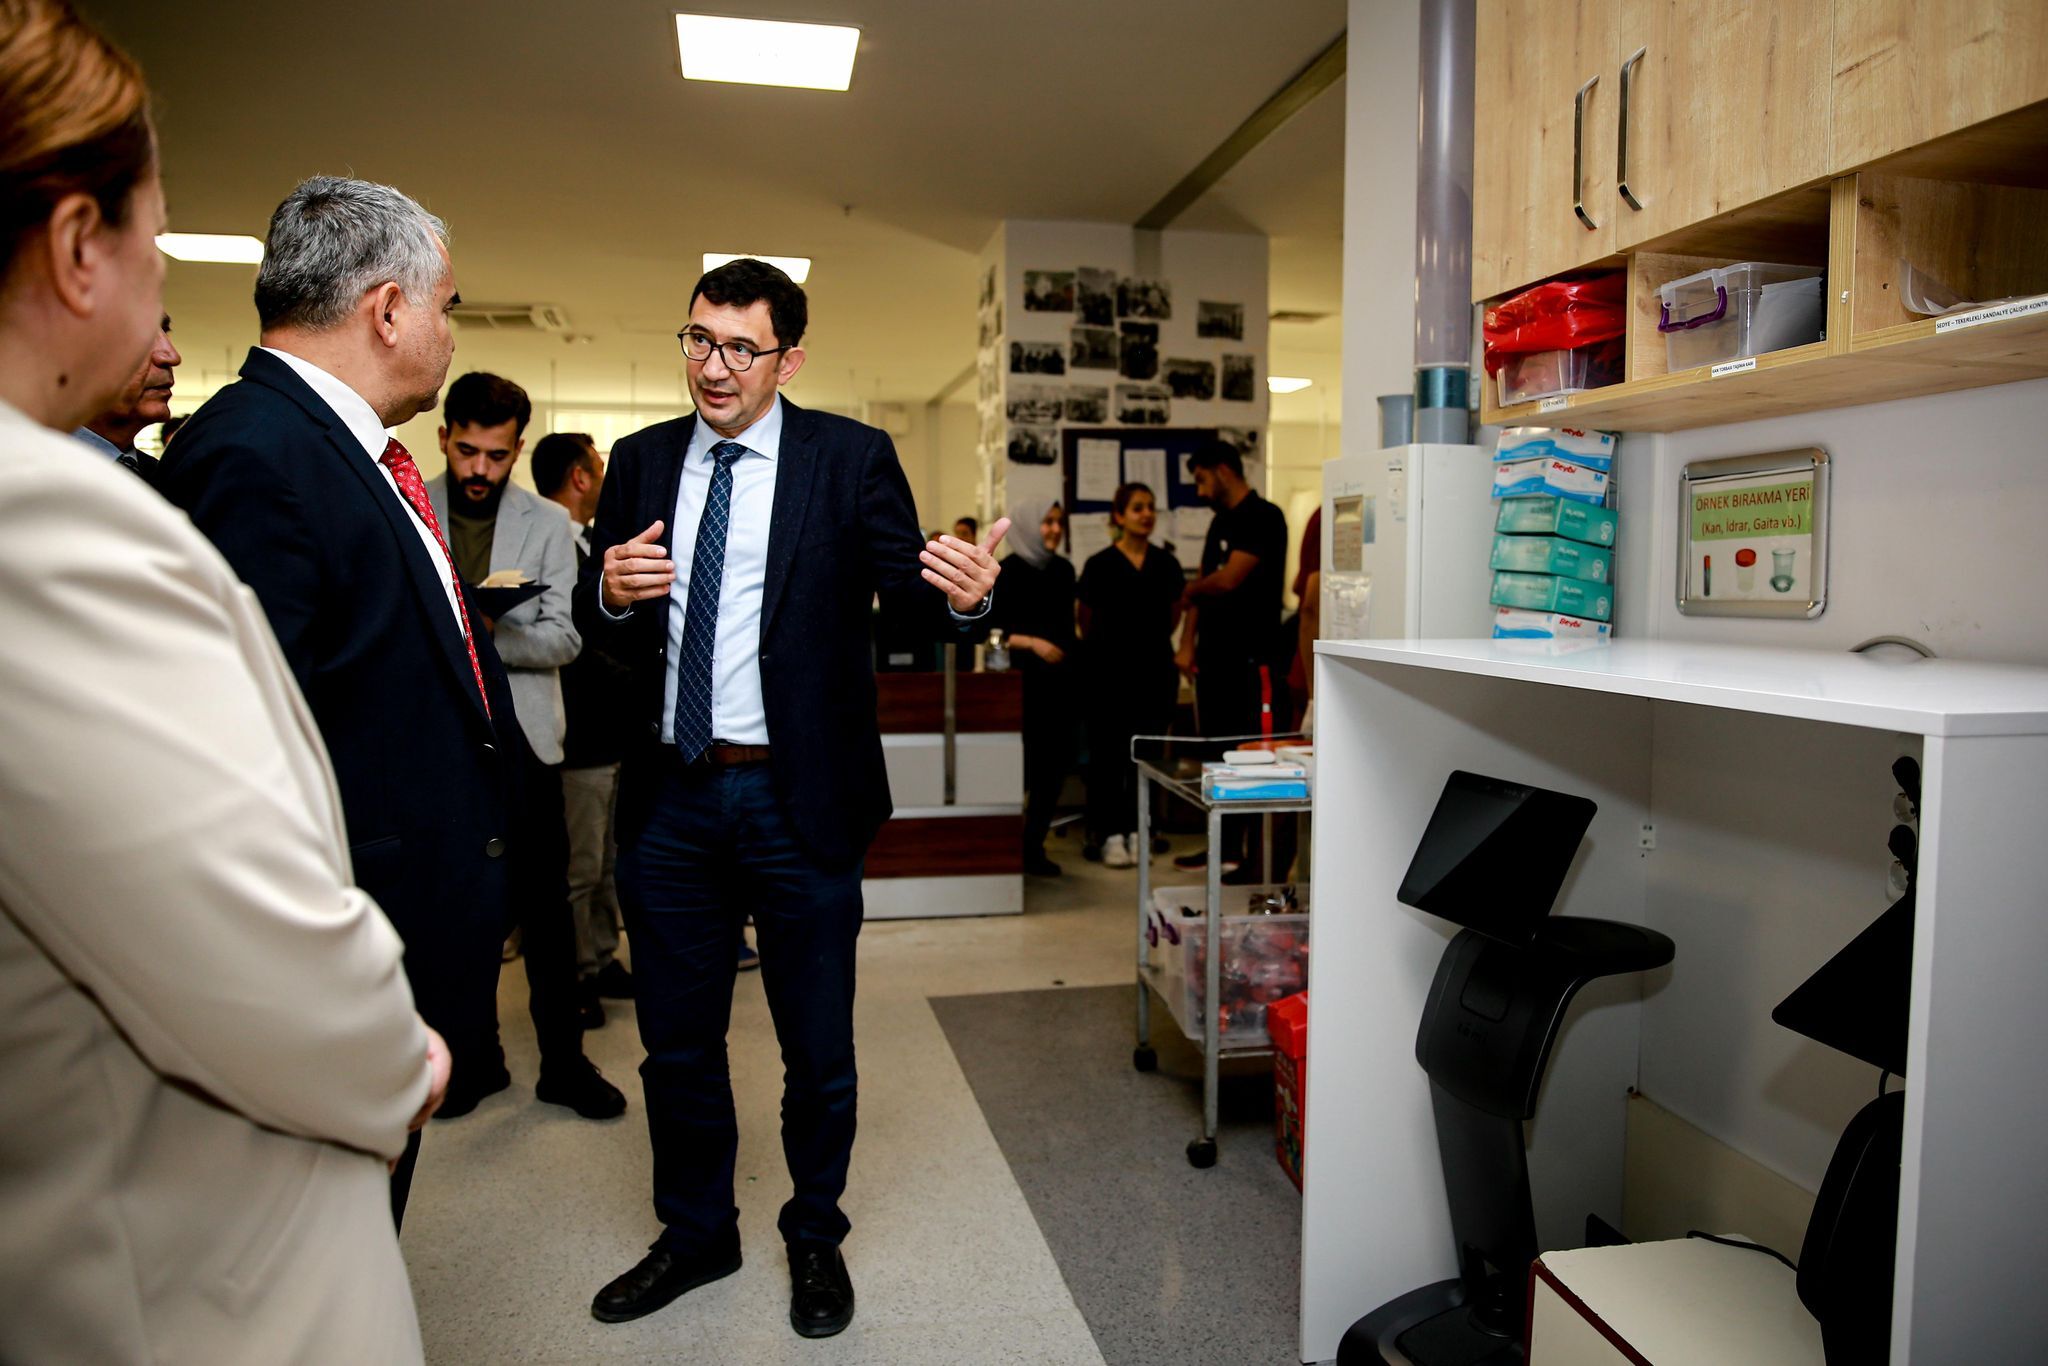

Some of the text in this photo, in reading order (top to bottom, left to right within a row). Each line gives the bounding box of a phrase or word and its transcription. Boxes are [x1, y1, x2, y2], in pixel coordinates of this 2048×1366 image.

[1937, 321, 1950, 329] SEDYE
[1982, 309, 2009, 320] SANDALYE
[1552, 461, 1577, 474] Beybi
[1696, 484, 1811, 511] ÖRNEK BIRAKMA YERİ
[1702, 513, 1801, 536] (Kan, İdrar, Gaita vb.)
